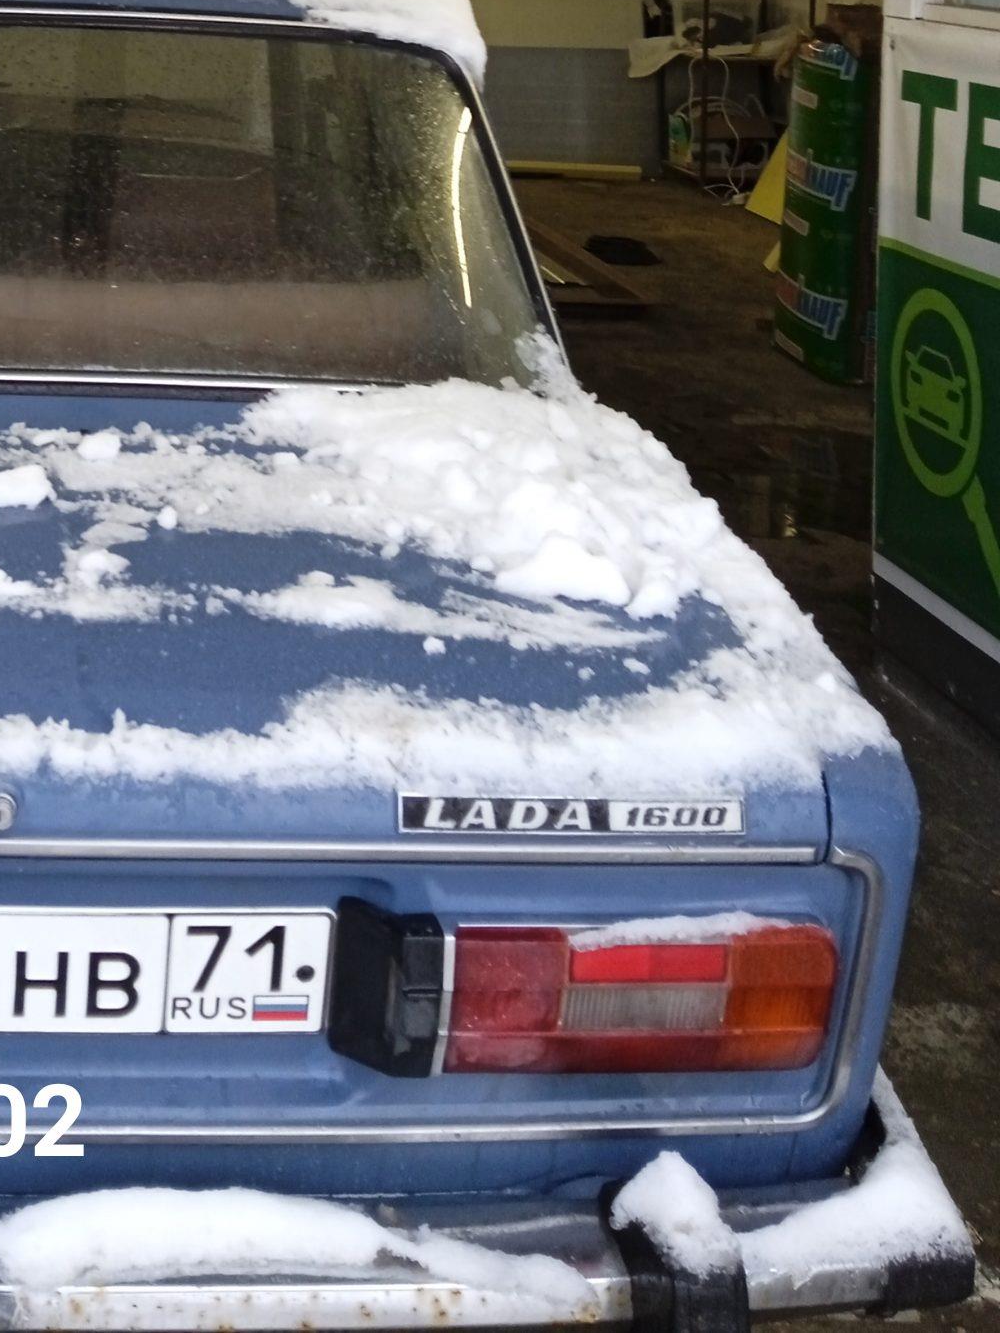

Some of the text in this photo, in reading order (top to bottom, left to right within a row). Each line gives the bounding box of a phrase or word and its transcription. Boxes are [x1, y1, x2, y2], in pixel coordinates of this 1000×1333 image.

[423, 798, 728, 831] LADA 1600
[186, 925, 286, 993] 71
[171, 997, 248, 1020] RUS
